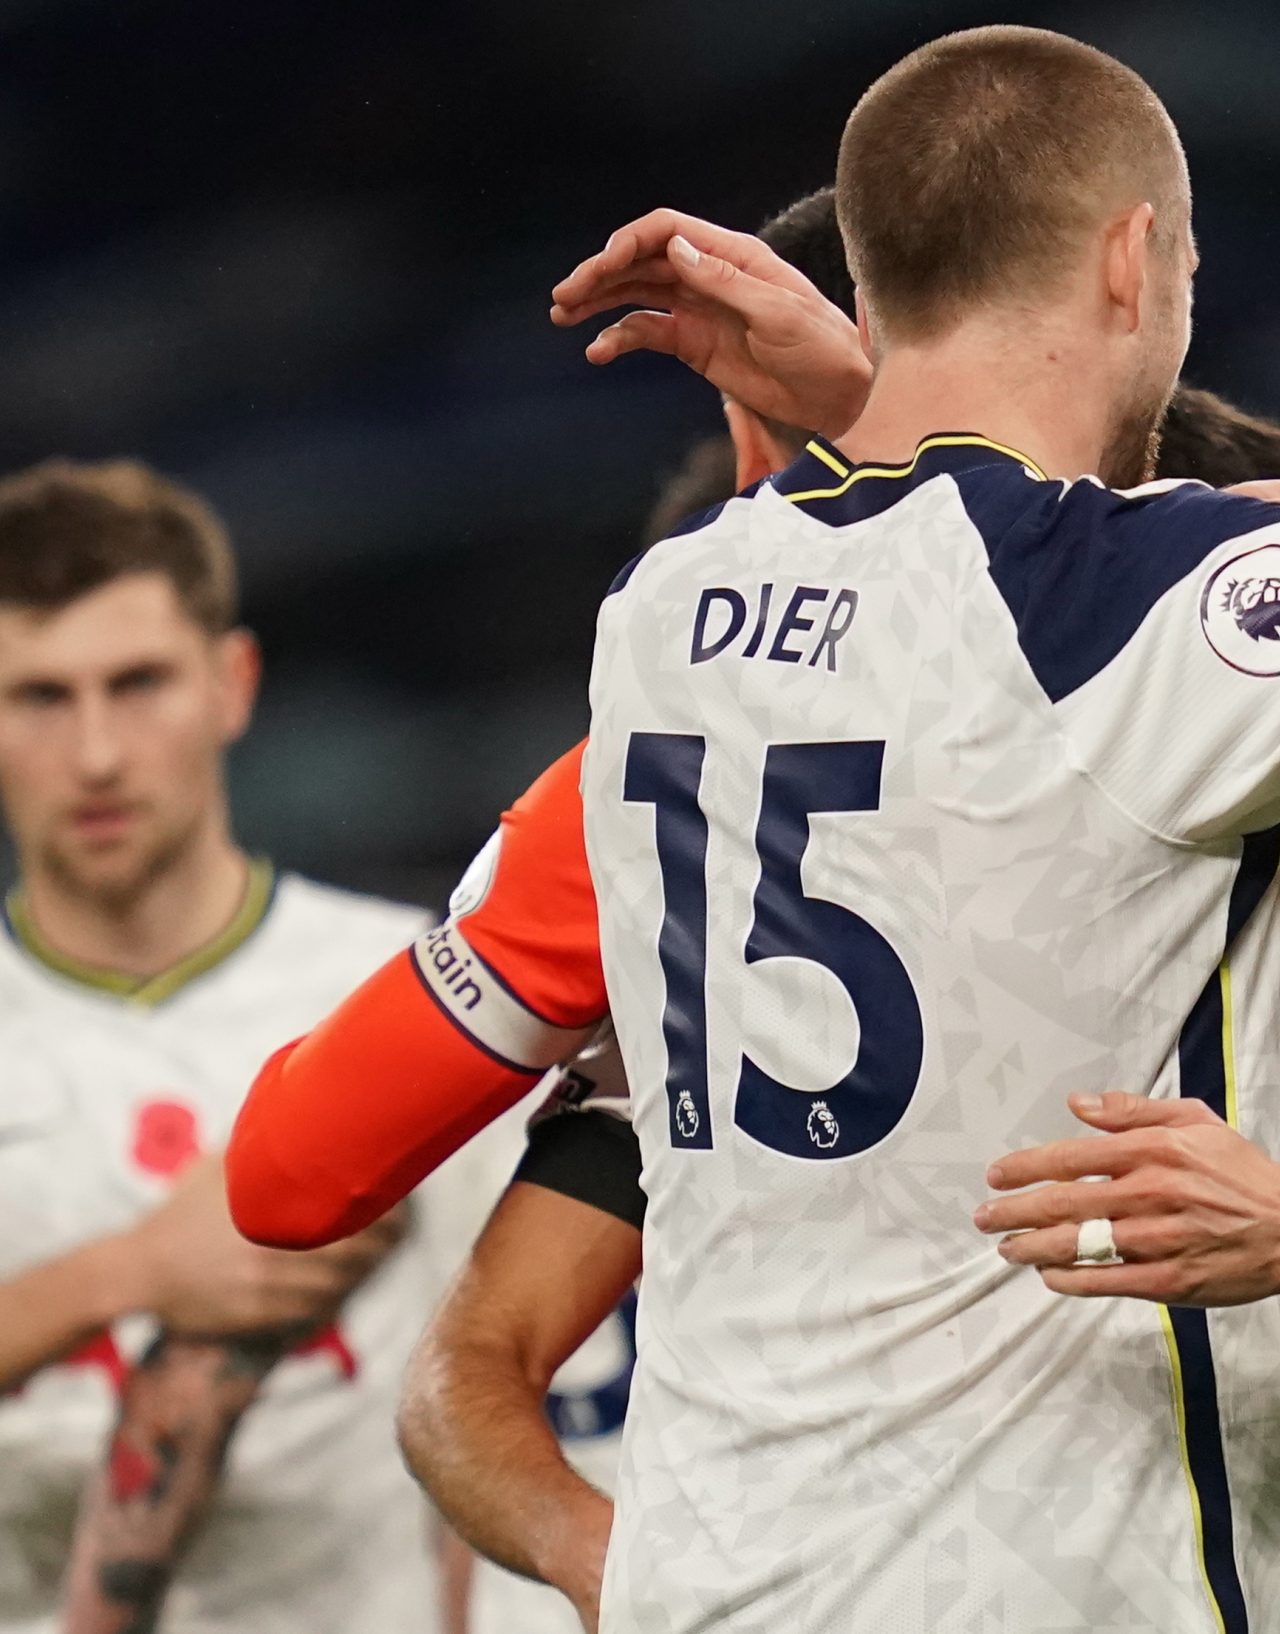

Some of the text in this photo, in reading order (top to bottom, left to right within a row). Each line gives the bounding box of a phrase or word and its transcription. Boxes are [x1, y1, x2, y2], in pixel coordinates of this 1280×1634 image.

[690, 583, 858, 672] DIER
[427, 928, 482, 1011] tain
[623, 732, 924, 1160] 15
